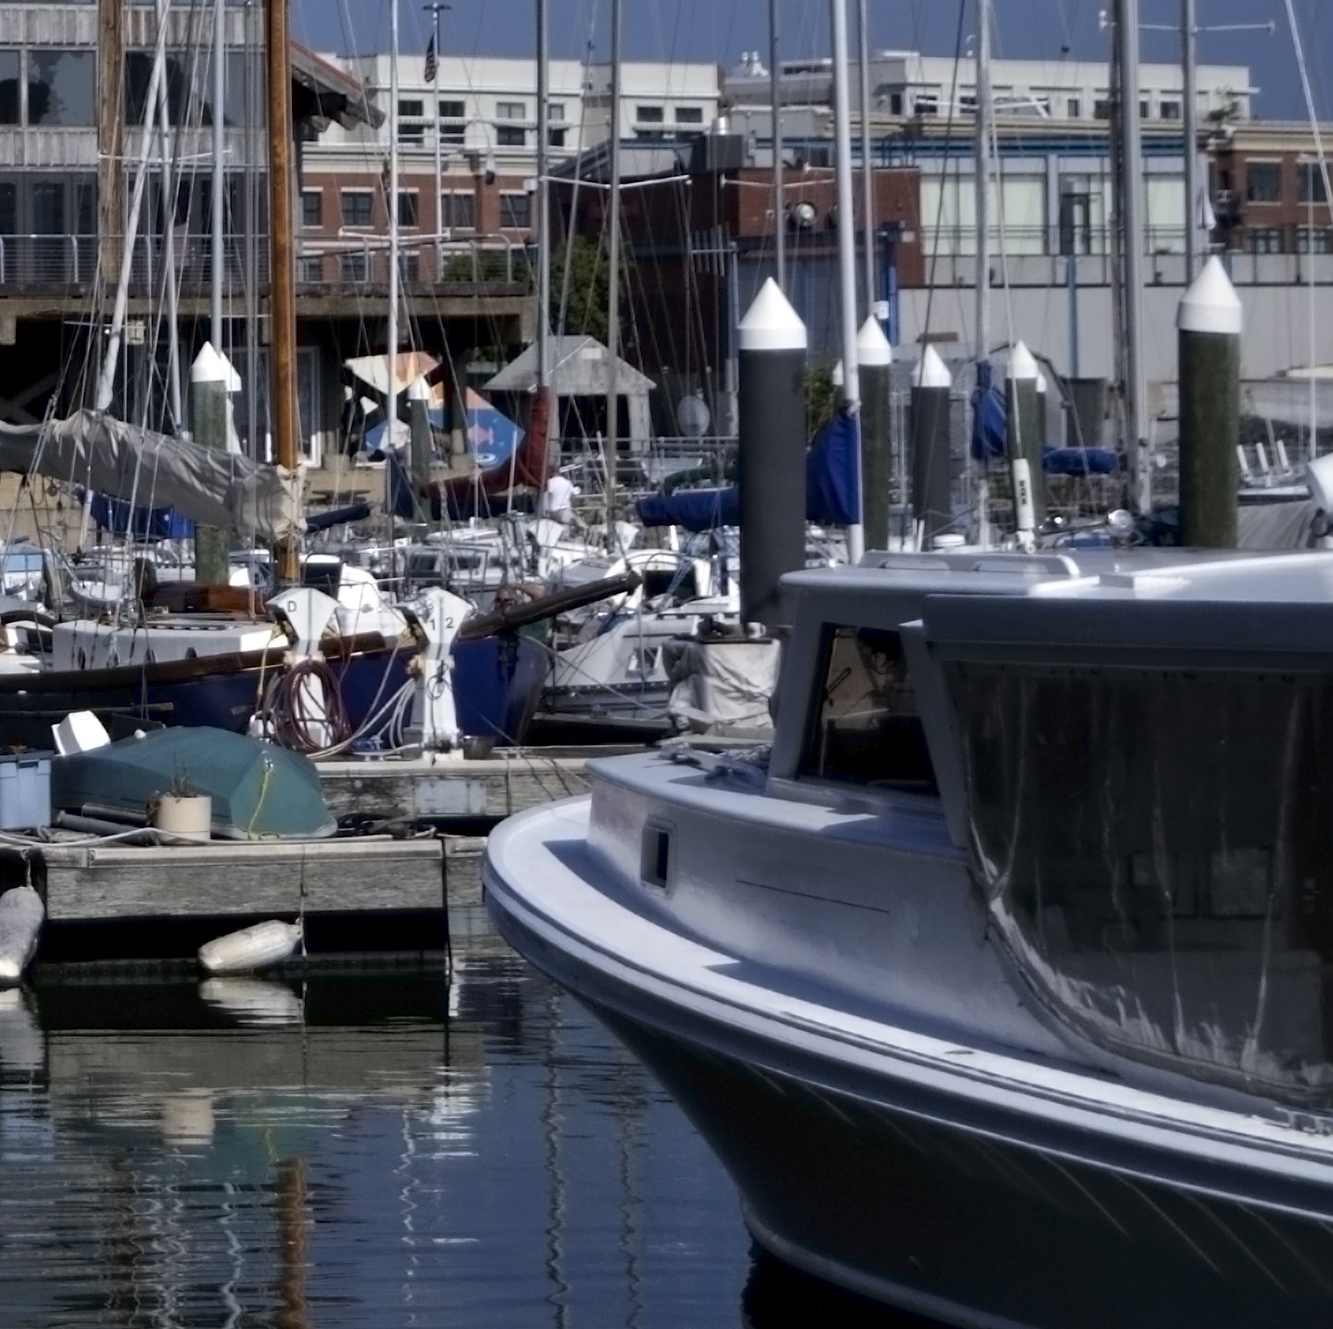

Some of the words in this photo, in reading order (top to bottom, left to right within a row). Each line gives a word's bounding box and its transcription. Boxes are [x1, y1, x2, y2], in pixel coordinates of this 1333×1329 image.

[287, 600, 297, 613] D
[429, 619, 436, 631] 1
[445, 616, 455, 629] 2
